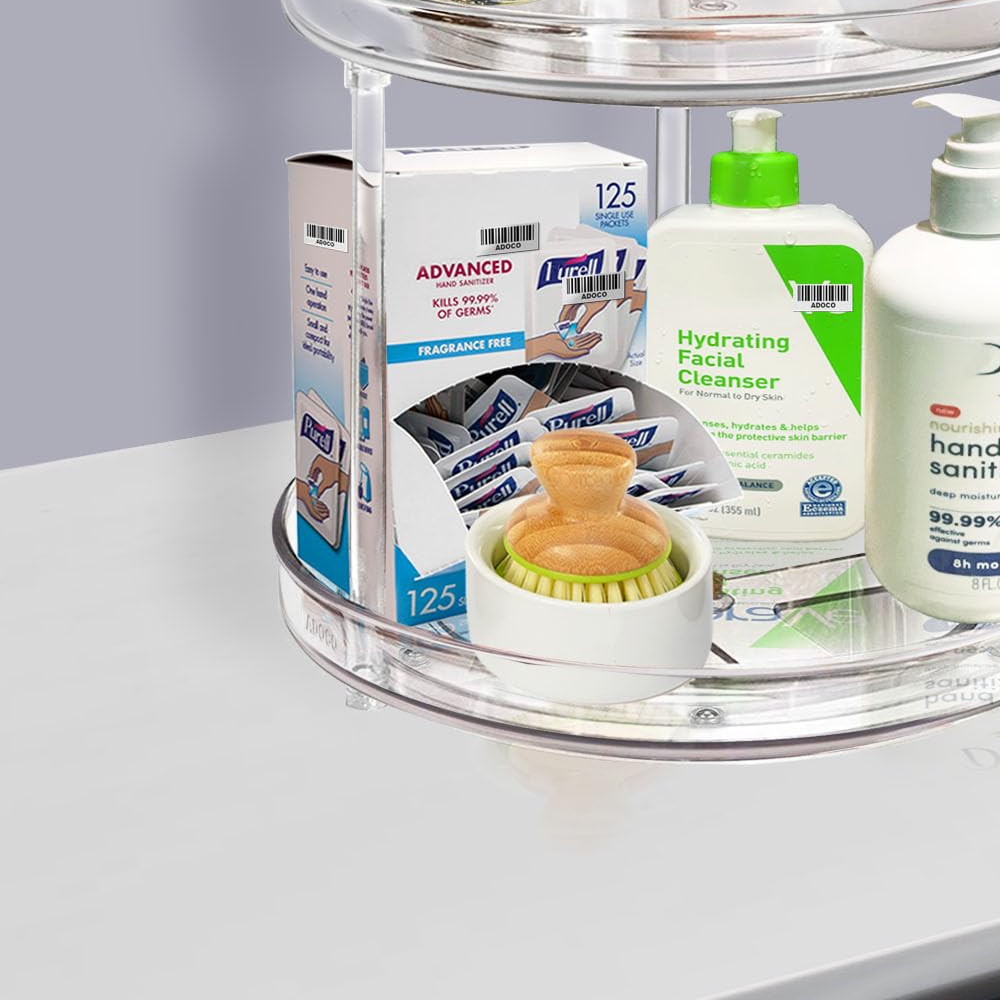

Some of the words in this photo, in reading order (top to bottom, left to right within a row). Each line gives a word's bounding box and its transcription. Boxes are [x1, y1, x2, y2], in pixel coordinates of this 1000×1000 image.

[595, 182, 636, 209] 125
[595, 212, 620, 221] SINGLE
[621, 211, 635, 219] USE
[600, 219, 630, 228] PACKETS
[495, 242, 522, 251] ADOCO
[416, 259, 513, 281] ADVANCED
[436, 280, 457, 289] HAND
[459, 277, 494, 287] SANITIZER
[432, 297, 459, 309] KILLS
[462, 293, 499, 305] 99.99%
[582, 291, 608, 300] ADOCO
[437, 309, 453, 320] OF
[418, 340, 485, 356] FRAGRANCE
[488, 337, 511, 348] FREE
[677, 329, 790, 353] Hydrating
[677, 349, 745, 368] Facial
[677, 369, 780, 389] Cleanser
[679, 388, 694, 396] For
[696, 390, 731, 400] Normal
[733, 392, 742, 400] to
[744, 393, 761, 402] Dry
[762, 393, 783, 401] Skin
[550, 405, 608, 430] Purell
[702, 420, 729, 430] nses,
[731, 421, 777, 432] hydrates
[779, 423, 788, 431] &
[791, 424, 819, 432] helps
[303, 417, 334, 454] Purell
[717, 431, 733, 440] the
[736, 432, 786, 442] protective
[788, 433, 808, 441] skin
[811, 432, 848, 441] barrier
[725, 450, 759, 459] sential
[761, 450, 815, 460] ceramides
[745, 462, 766, 470] acid
[929, 487, 956, 500] deep
[721, 505, 742, 515] (355
[744, 507, 761, 516] ml)
[929, 526, 965, 537] effective
[929, 534, 960, 545] against
[962, 538, 991, 547] germs
[953, 558, 971, 569] 8h
[972, 578, 980, 590] 8
[407, 583, 457, 617] 125
